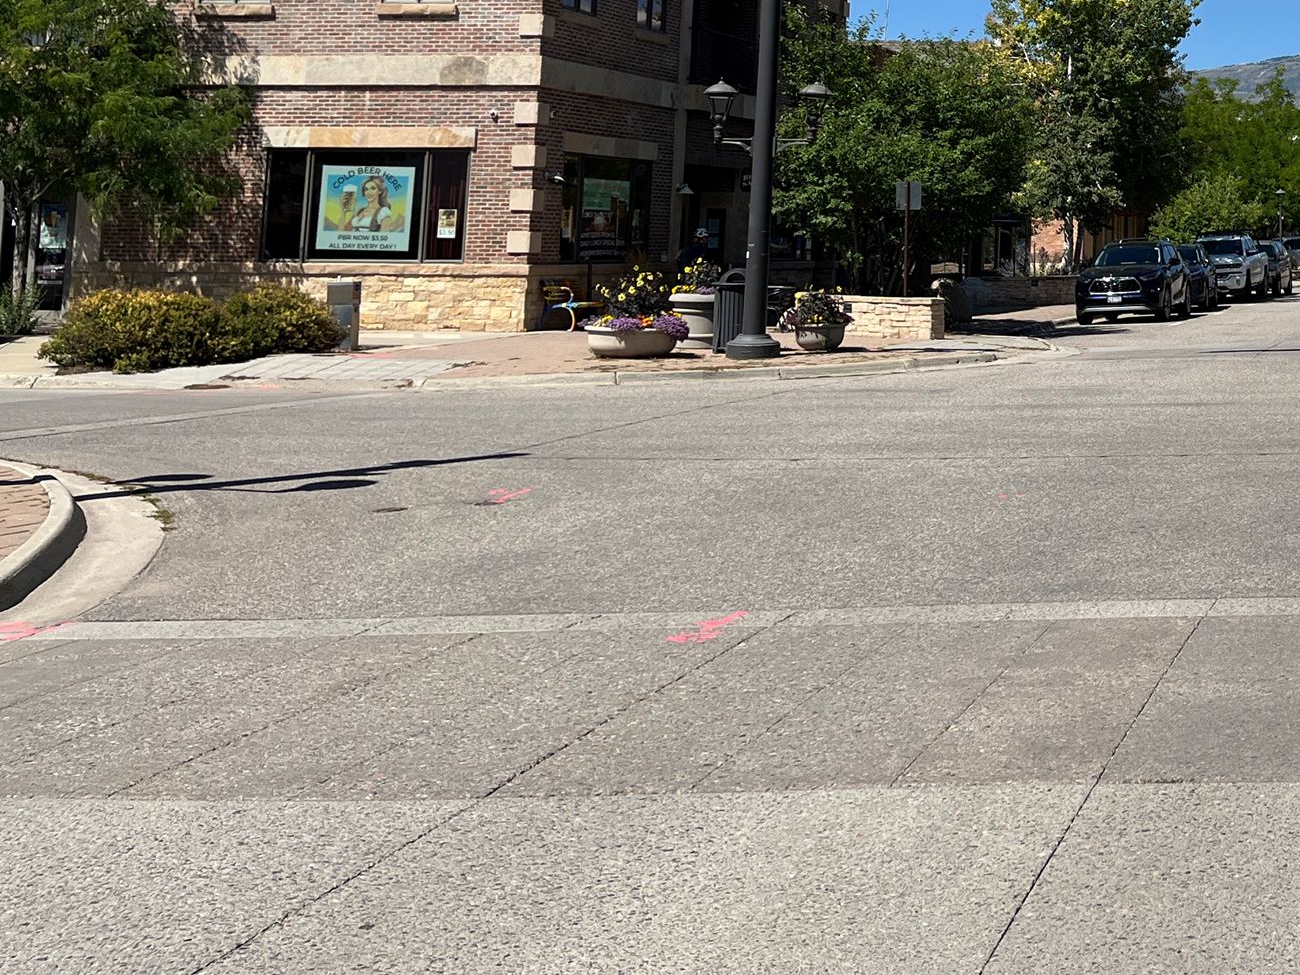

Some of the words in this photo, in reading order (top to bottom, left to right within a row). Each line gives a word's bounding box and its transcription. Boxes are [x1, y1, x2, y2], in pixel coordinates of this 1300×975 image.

[332, 170, 356, 190] COLD
[357, 166, 382, 176] BEER
[382, 171, 402, 192] HERE
